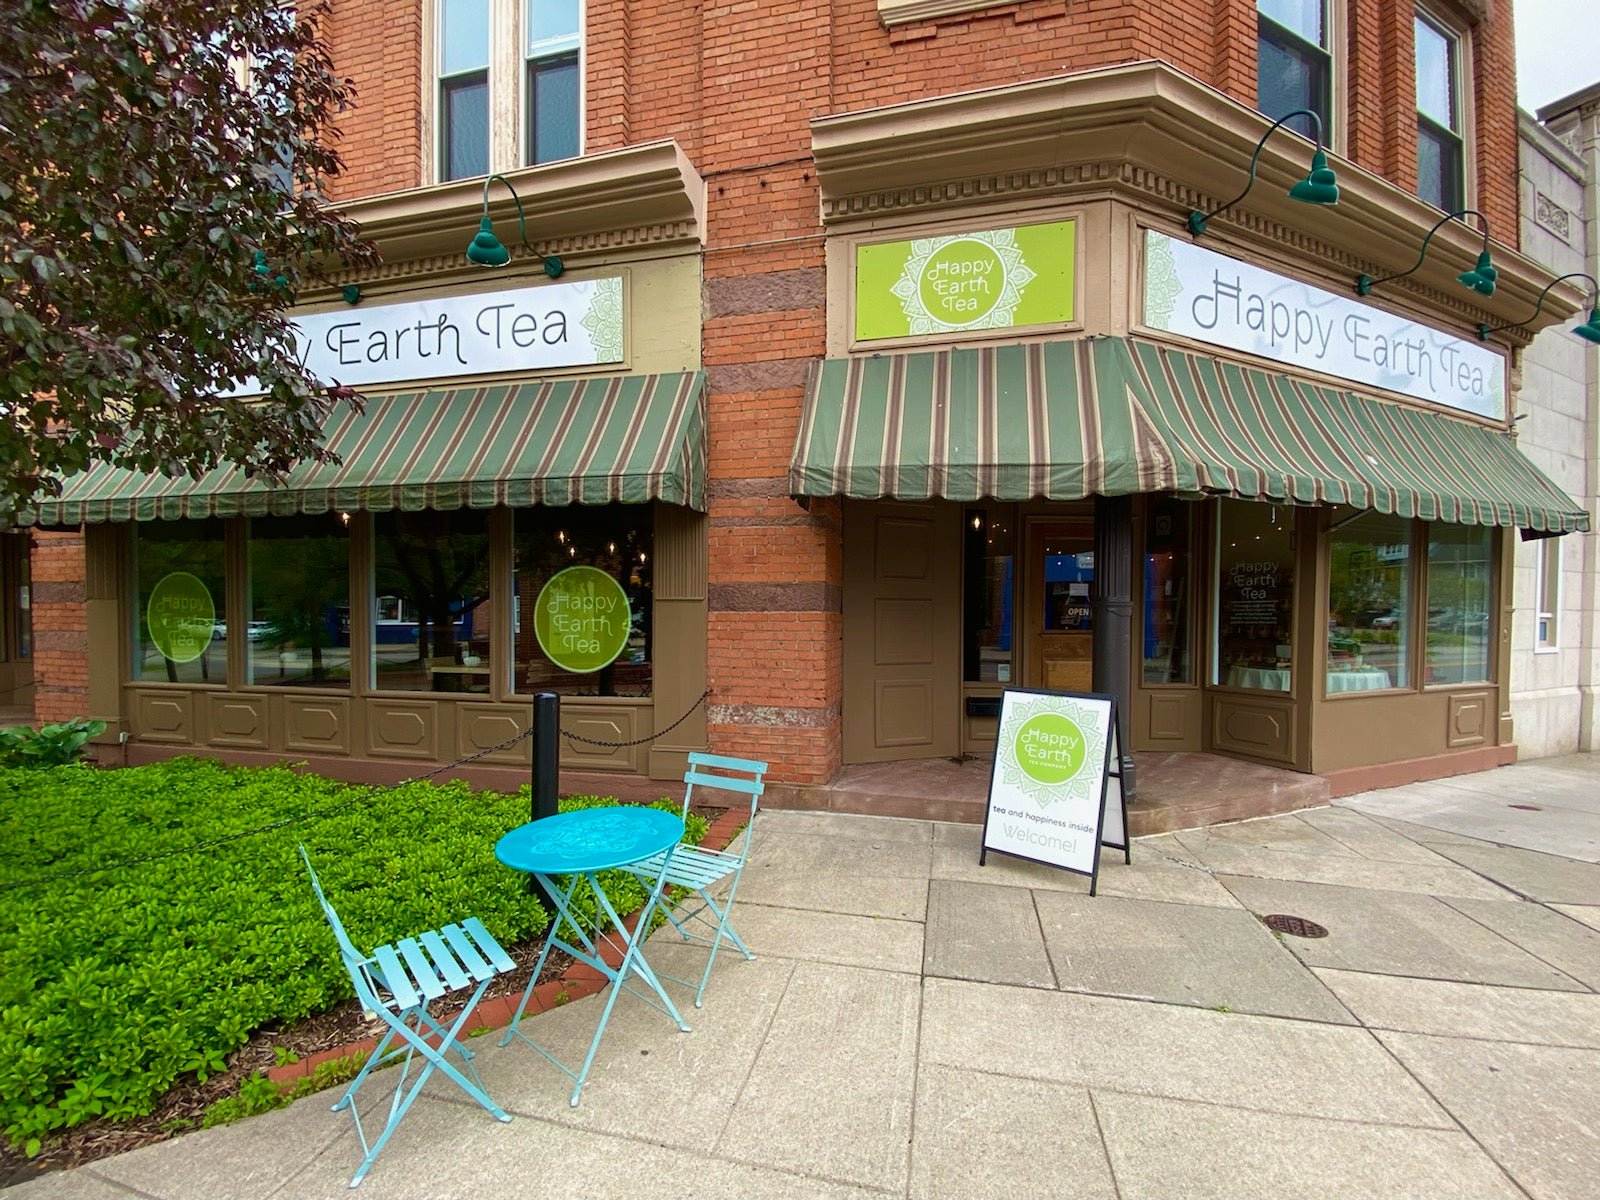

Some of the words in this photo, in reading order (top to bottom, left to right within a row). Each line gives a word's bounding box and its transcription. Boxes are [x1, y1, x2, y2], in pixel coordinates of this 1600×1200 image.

[927, 259, 995, 280] Happy
[933, 276, 990, 295] Earth
[942, 296, 978, 312] Tea
[325, 314, 468, 366] Earth
[475, 303, 568, 349] Tea
[1191, 268, 1334, 359] Happy
[1343, 313, 1437, 394] Earth
[1439, 345, 1484, 397] Tea
[1229, 561, 1280, 576] Happy
[1234, 574, 1276, 587] Earth
[546, 592, 618, 614] Happy
[1240, 587, 1267, 599] Tea
[1068, 608, 1089, 616] OPEN
[552, 615, 614, 636] Earth
[168, 630, 194, 646] Tea
[562, 634, 601, 654] Tea
[1021, 728, 1078, 749] Happy
[1024, 744, 1072, 766] Earth
[993, 804, 1006, 815] tea
[1007, 809, 1024, 819] and
[1025, 811, 1066, 827] happiness
[1068, 821, 1095, 834] inside
[1003, 822, 1077, 853] Welcome!
